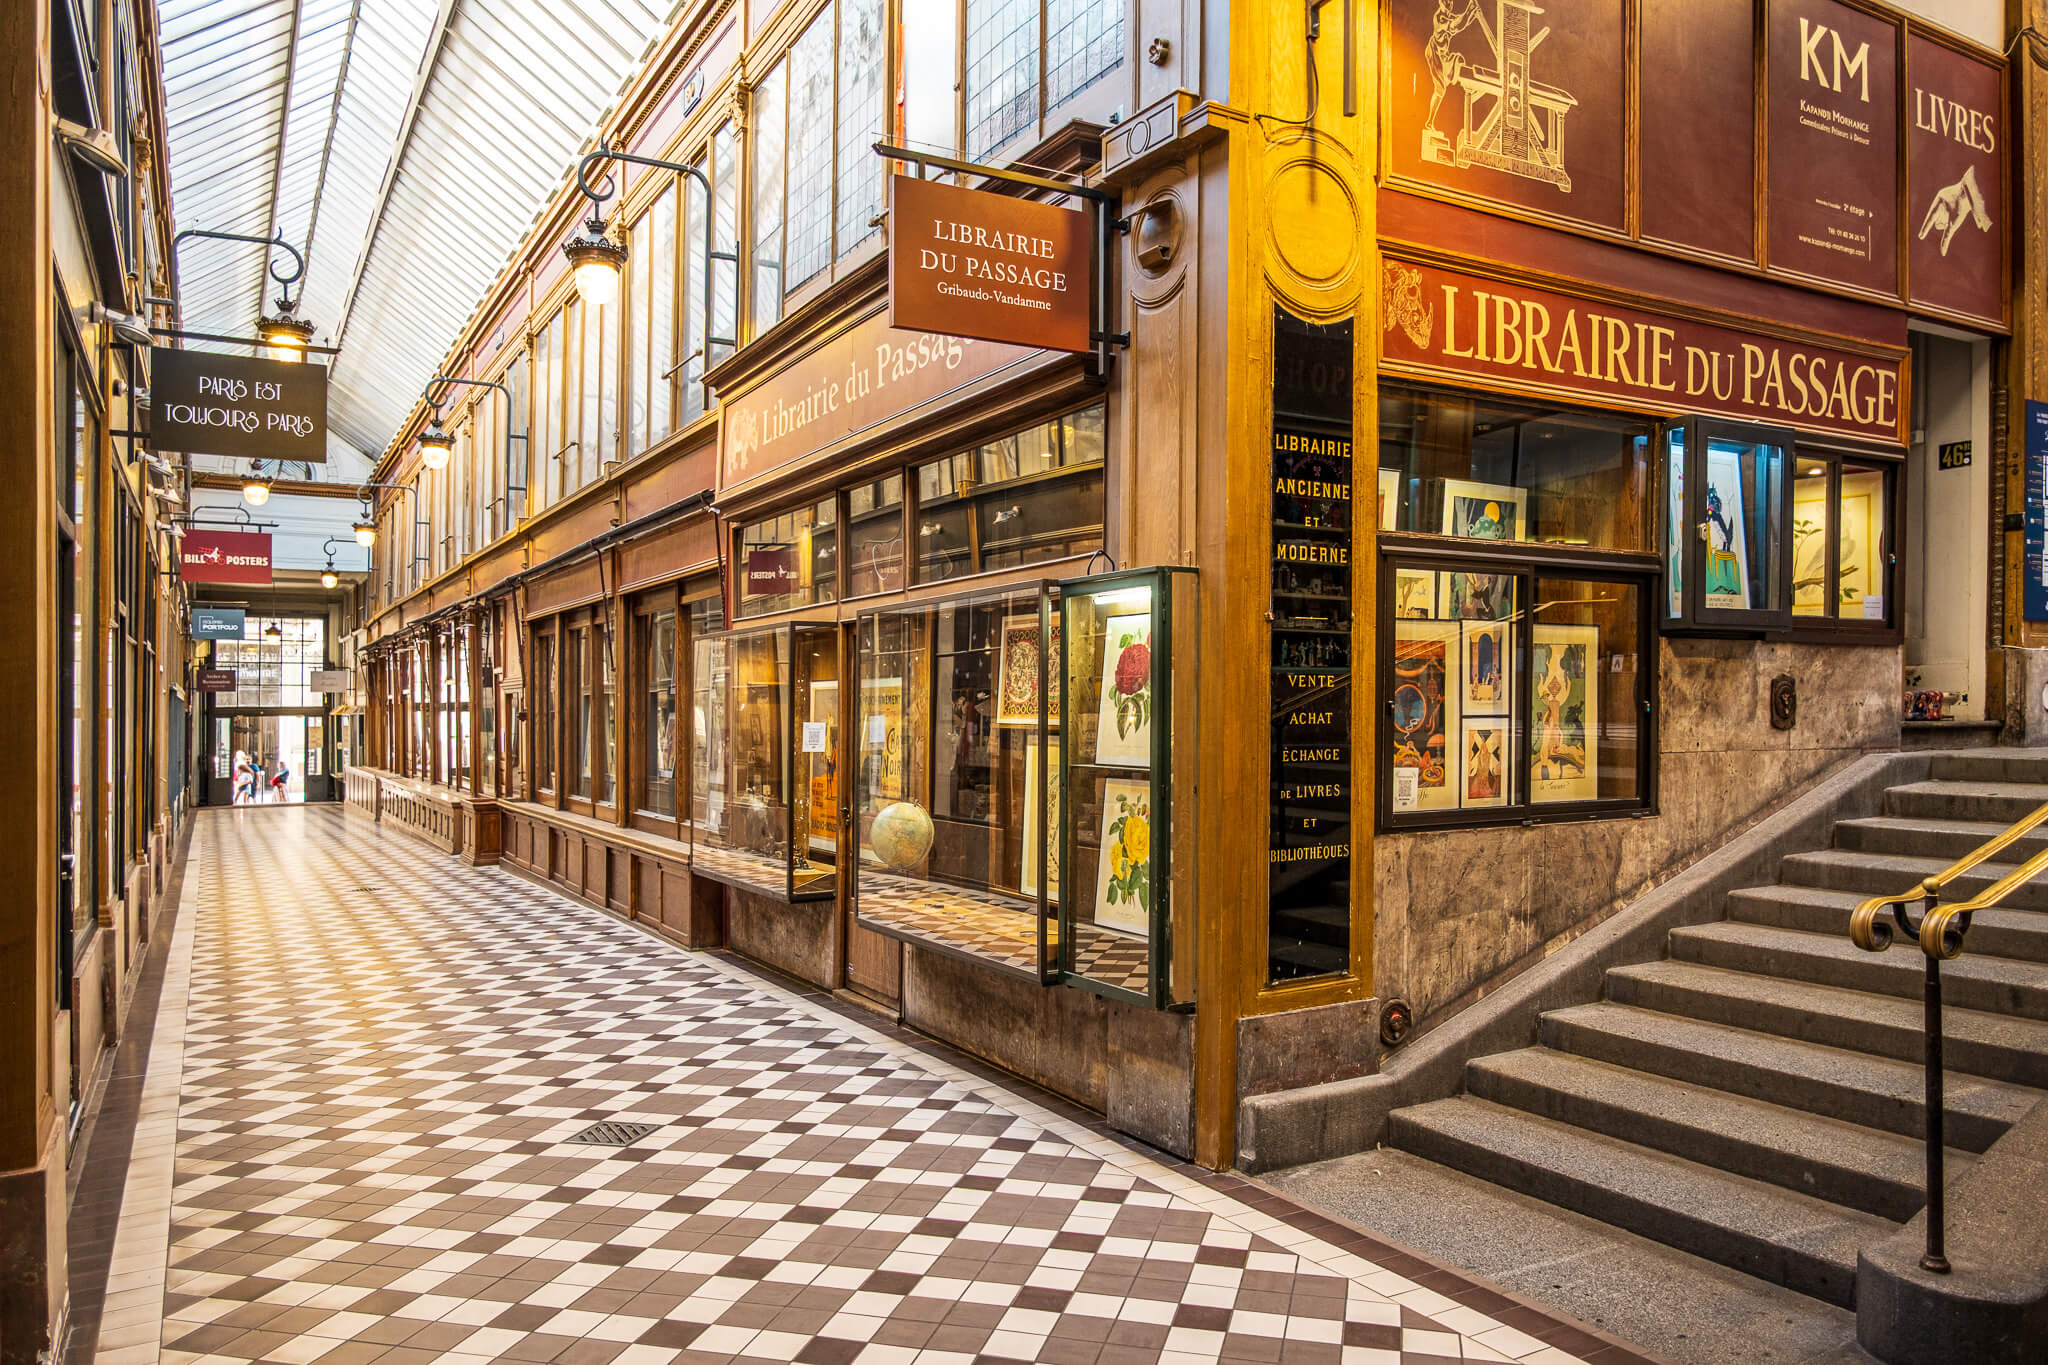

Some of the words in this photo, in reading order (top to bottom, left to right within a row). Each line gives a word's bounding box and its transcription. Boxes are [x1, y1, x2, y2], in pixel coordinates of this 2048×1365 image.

[1799, 17, 1870, 103] KM
[1914, 87, 1995, 154] LIVRES
[933, 219, 1055, 260] LIBRAIRIE
[920, 249, 957, 273] DU
[965, 257, 1067, 292] PASSAGE
[937, 281, 1052, 311] Gribaudo-Vandamme
[1441, 285, 1676, 392] LIBRAIRIE
[1685, 346, 1735, 401] DU
[1741, 343, 1897, 428] PASSAGE
[198, 376, 248, 402] PARIS
[255, 381, 283, 401] EST
[762, 377, 840, 446] Librairie
[844, 361, 871, 404] du
[875, 334, 975, 390] Passag
[165, 404, 260, 433] TOUJOURS
[267, 413, 314, 438] PARIS
[1275, 433, 1351, 458] LIBRAIRIE
[1942, 444, 1964, 467] 46
[1275, 478, 1350, 500] ANCIENNE
[1304, 516, 1320, 528] ET
[184, 554, 207, 565] BILL
[226, 555, 269, 567] POSTERS
[1277, 543, 1348, 564] MODERNE
[1288, 674, 1335, 688] VENTE
[1289, 712, 1334, 726] ACHAT
[1282, 747, 1341, 763] ÉCHANGE
[1280, 789, 1292, 800] DE
[1296, 783, 1341, 798] LIVRES
[1303, 818, 1318, 828] ET
